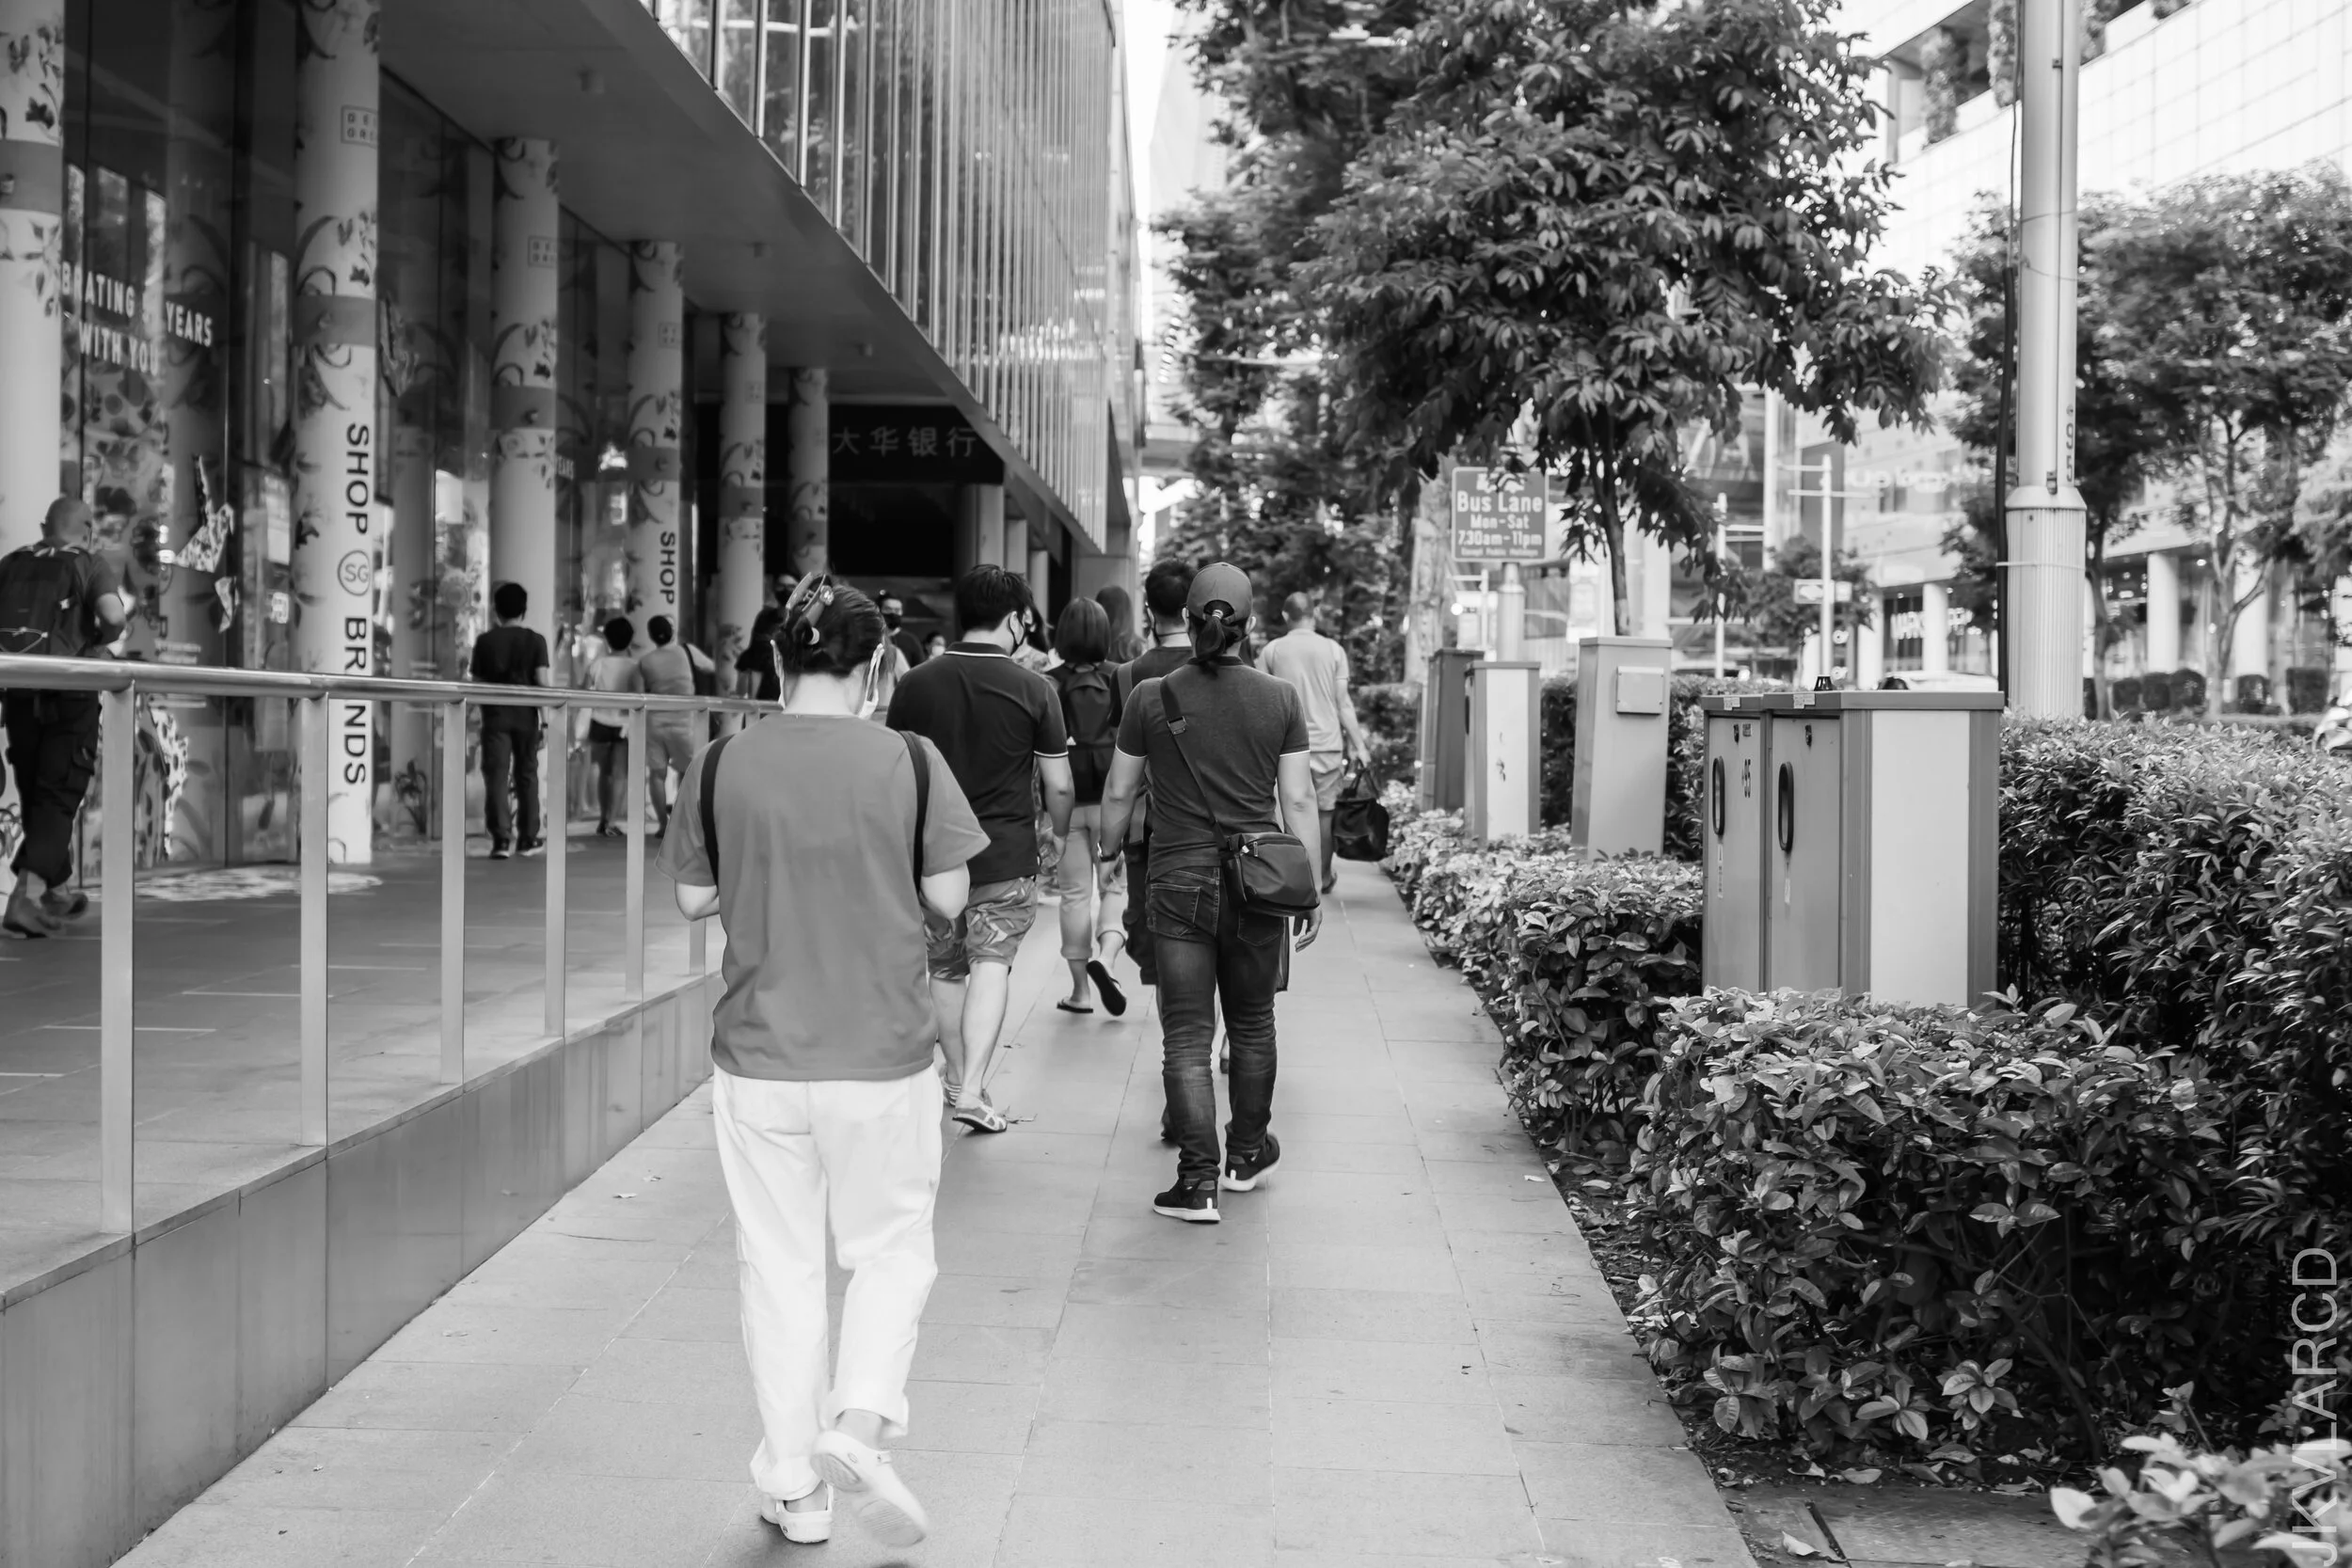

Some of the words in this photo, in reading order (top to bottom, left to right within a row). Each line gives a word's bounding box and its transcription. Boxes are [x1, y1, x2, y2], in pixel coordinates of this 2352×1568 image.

[79, 320, 122, 365] WITH
[128, 334, 159, 376] YOU
[166, 300, 213, 347] YEARS
[832, 426, 977, 458] 大华银行
[345, 422, 370, 534] SHOP
[1456, 490, 1492, 513] Bus
[1498, 490, 1543, 513] Lane
[343, 563, 369, 583] SG
[660, 531, 675, 604] SHOP
[343, 616, 367, 785] BRNDS
